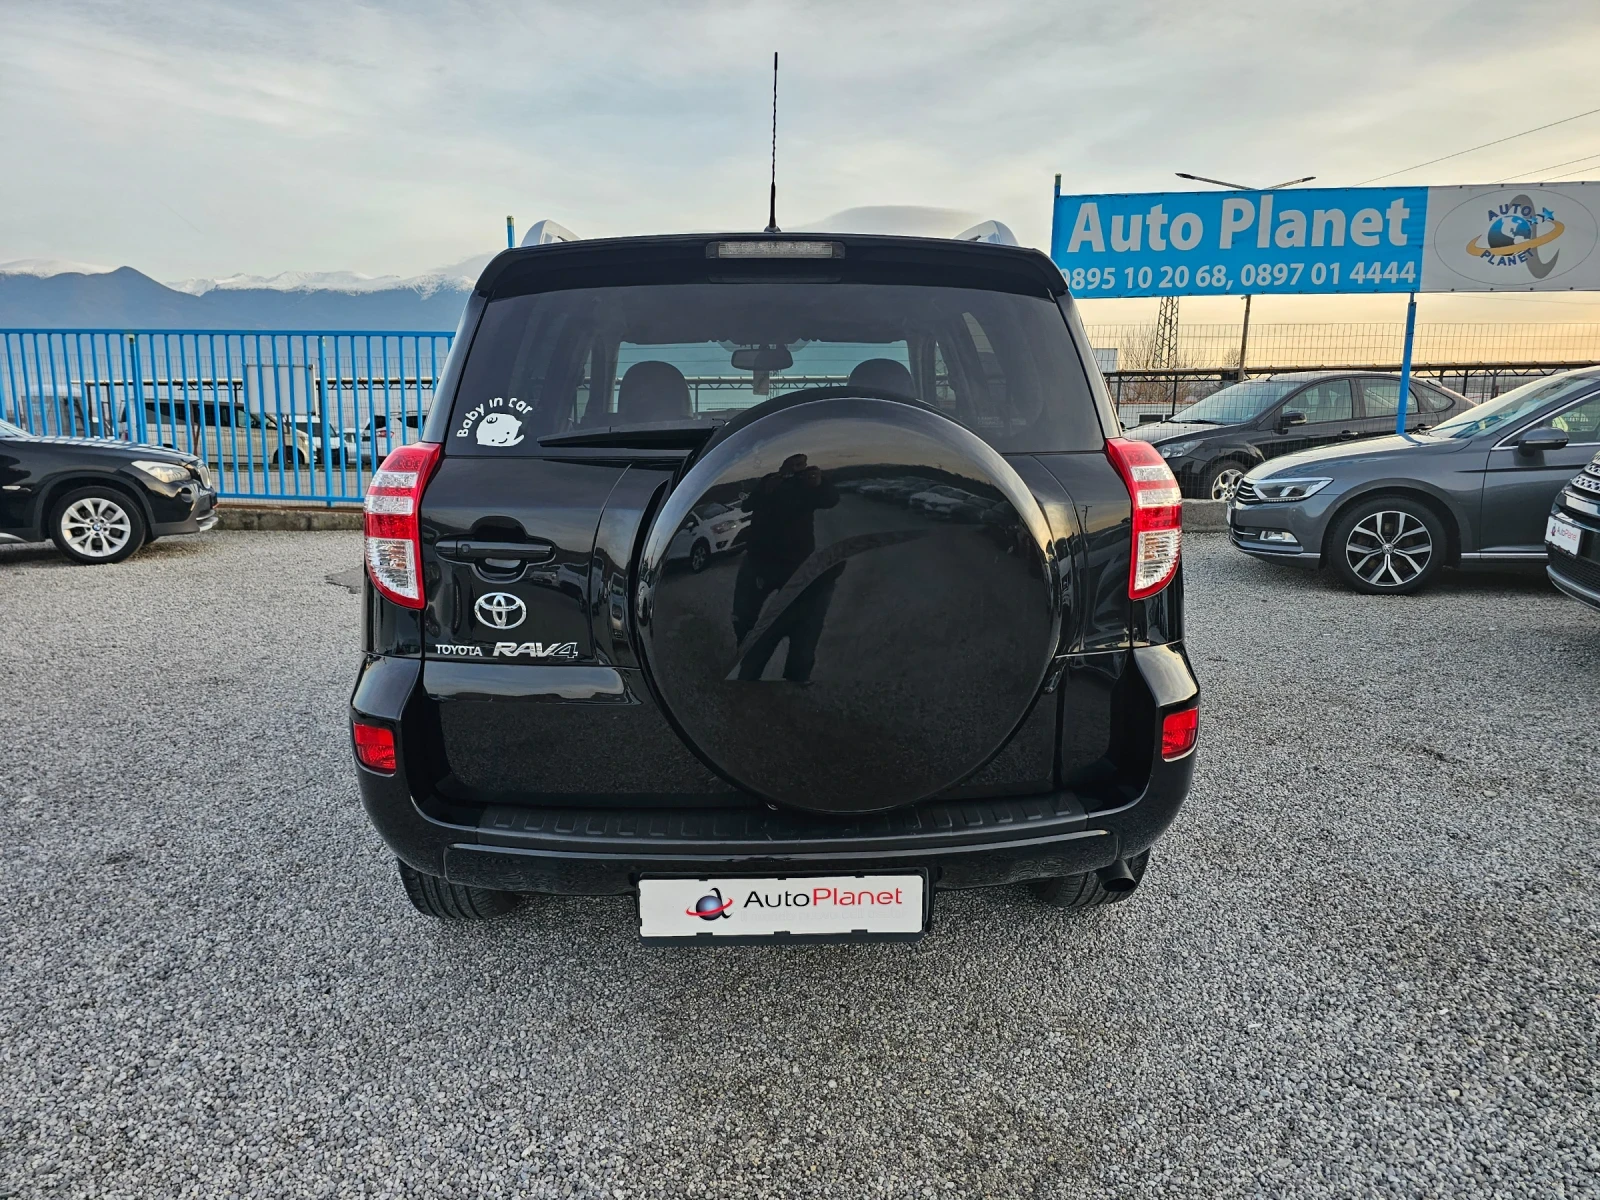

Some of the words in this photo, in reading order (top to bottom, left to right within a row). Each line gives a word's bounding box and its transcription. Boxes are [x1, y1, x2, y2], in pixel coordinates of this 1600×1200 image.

[1487, 203, 1532, 221] AUTO
[1066, 202, 1204, 253] Auto
[1219, 194, 1410, 249] Planet
[1480, 248, 1534, 266] PLANET
[1124, 266, 1153, 289] 10
[1160, 265, 1191, 288] 20
[1195, 264, 1233, 290] 68,
[1240, 263, 1305, 287] 0897
[1311, 262, 1340, 285] 01
[1349, 261, 1416, 284] 4444
[456, 403, 485, 437] Baby
[489, 397, 503, 408] in
[508, 397, 533, 414] car
[435, 644, 483, 657] TOYOTA
[492, 641, 579, 659] RAV4
[743, 887, 903, 908] AutoPlanet
